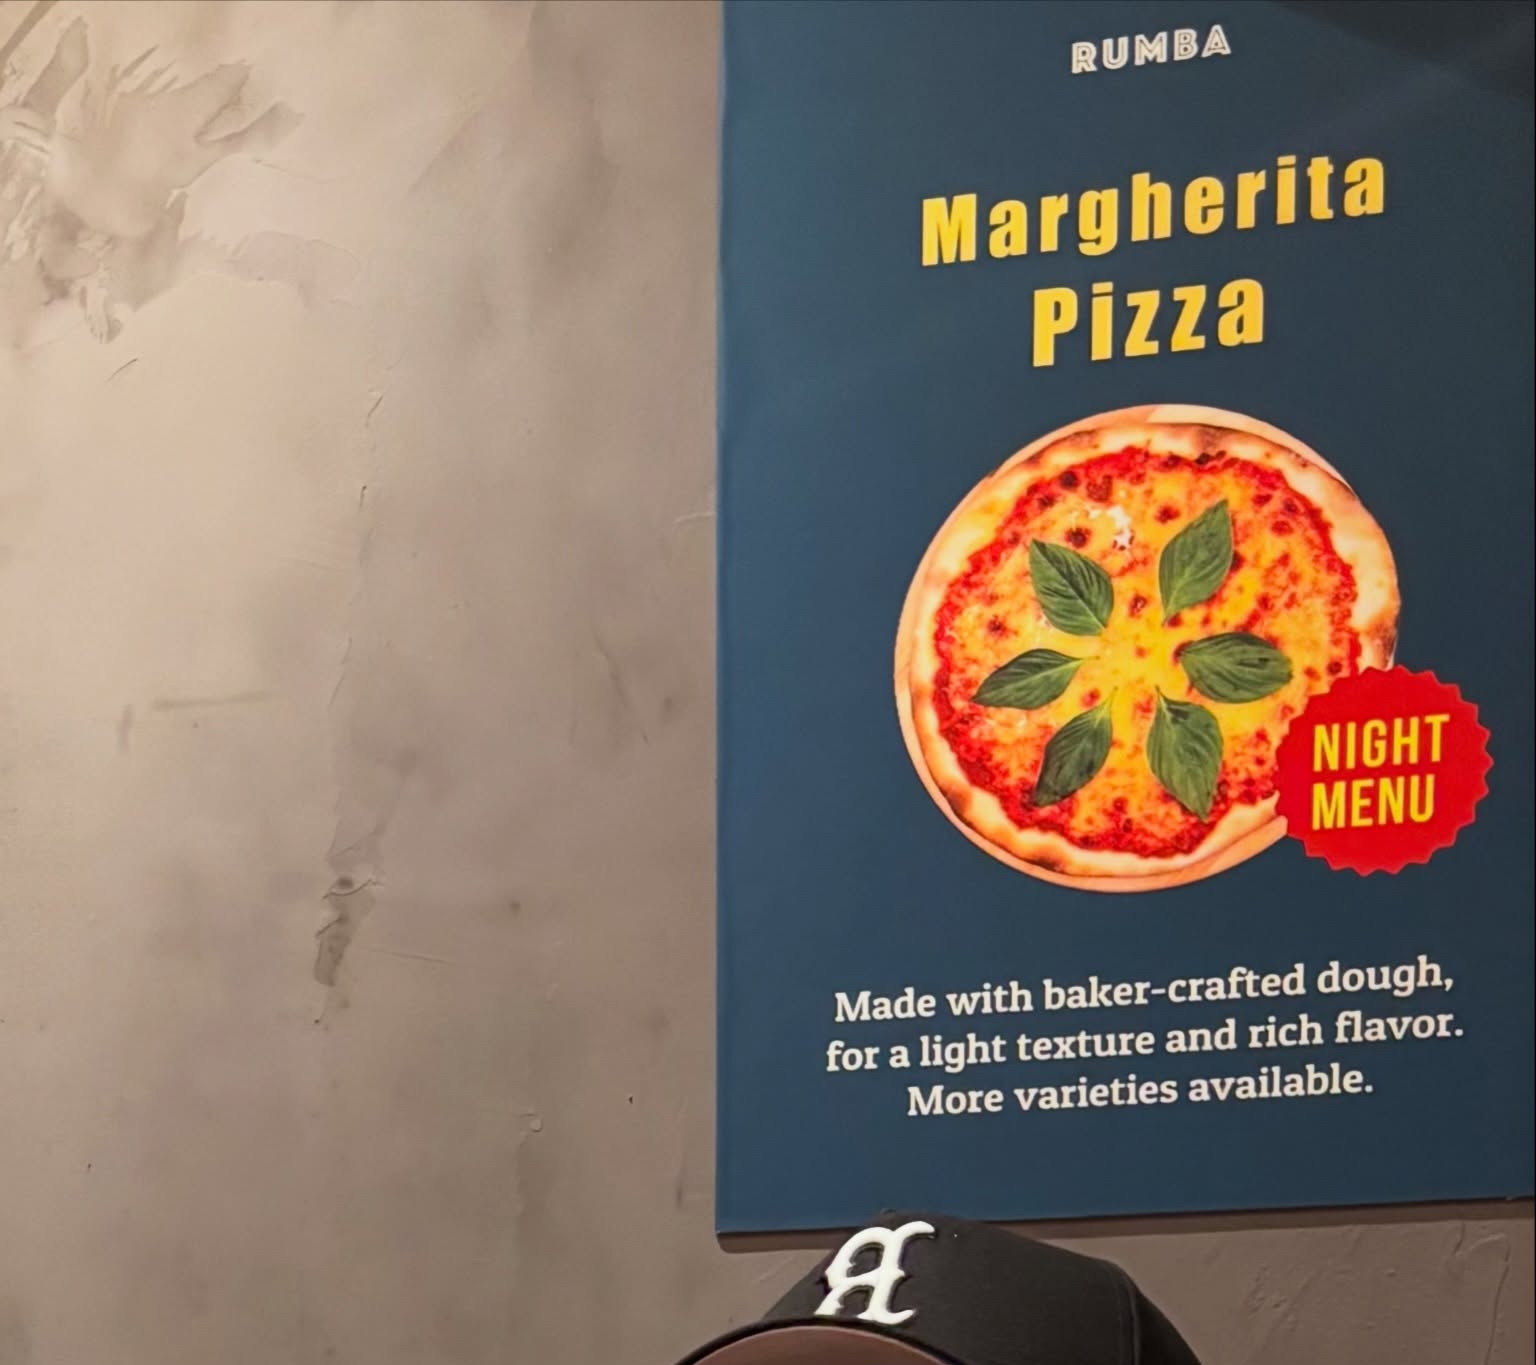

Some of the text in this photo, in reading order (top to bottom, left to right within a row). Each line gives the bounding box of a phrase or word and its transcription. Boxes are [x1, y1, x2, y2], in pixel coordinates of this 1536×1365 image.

[1072, 25, 1230, 73] RUMBA
[922, 156, 1383, 266] Margherita
[1033, 279, 1263, 366] Pizza
[1314, 715, 1449, 771] NIGHT
[1313, 775, 1434, 829] MENU
[836, 955, 1452, 1021] Made with baker-crafted dough,
[827, 1011, 1462, 1073] for a light texture and rich flavor.
[908, 1063, 1372, 1115] More varieties available.
